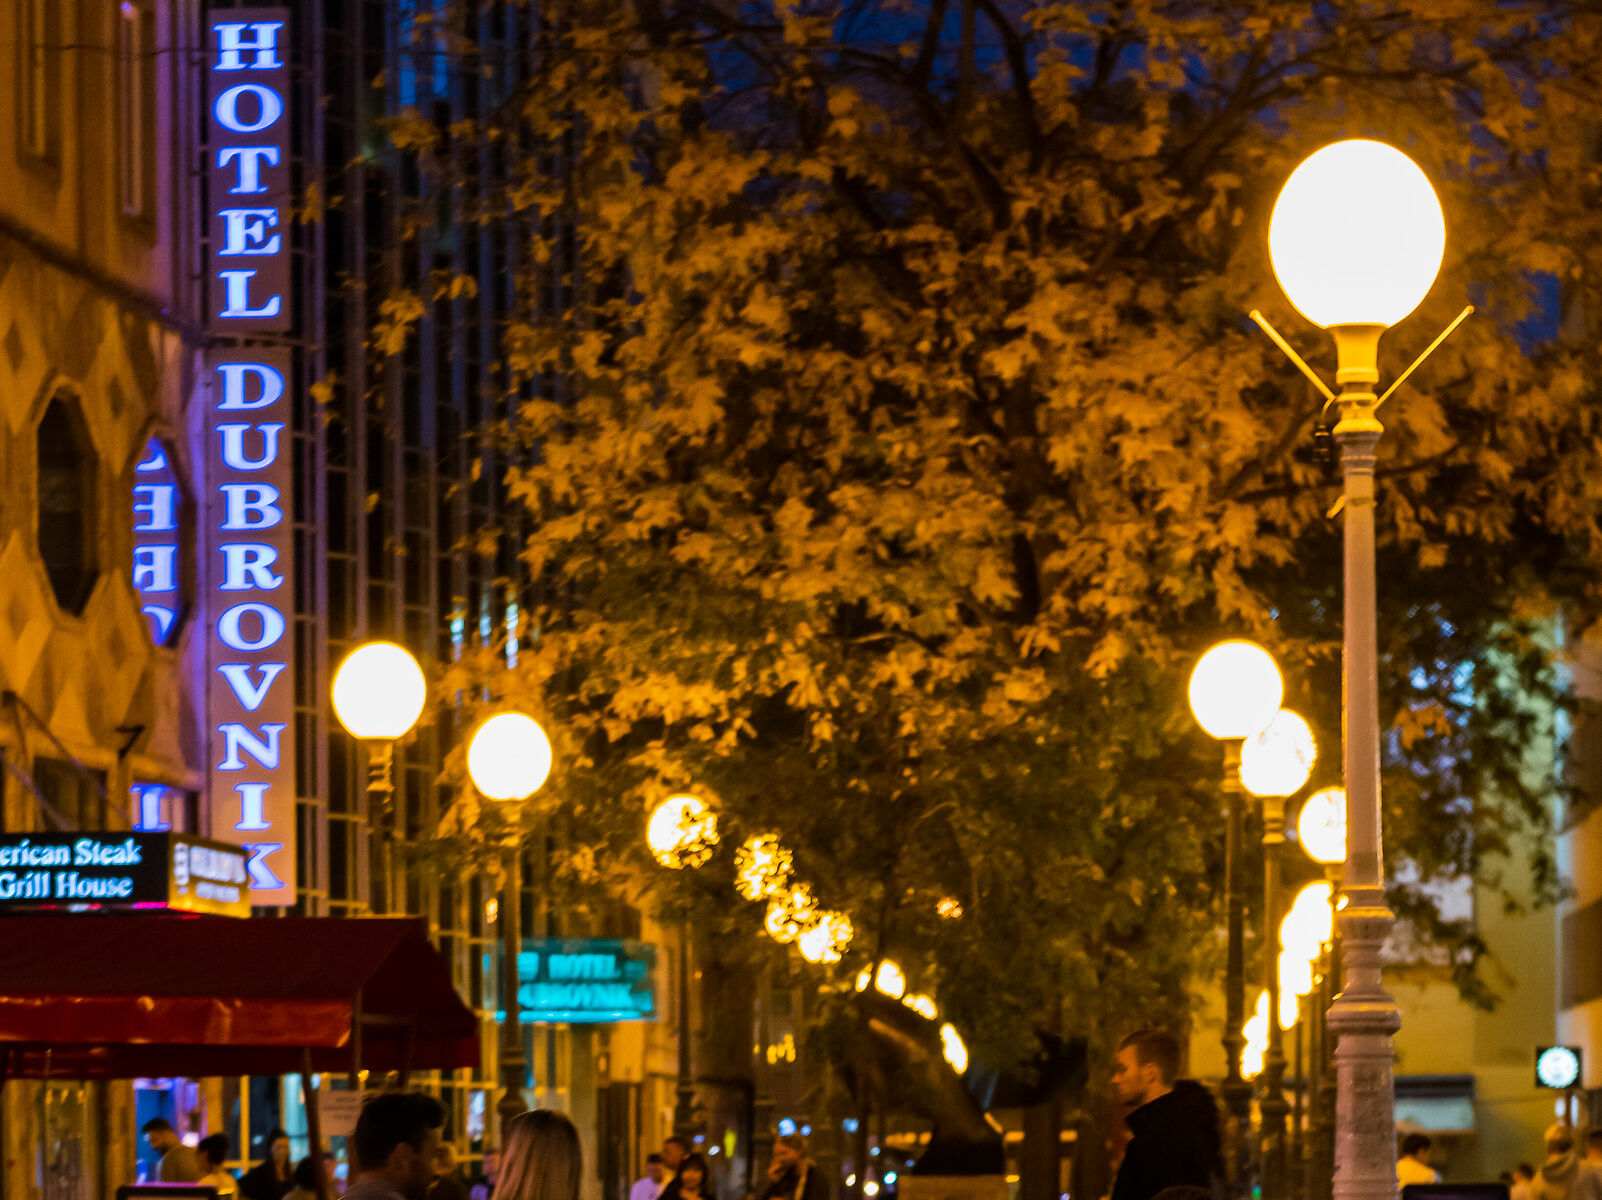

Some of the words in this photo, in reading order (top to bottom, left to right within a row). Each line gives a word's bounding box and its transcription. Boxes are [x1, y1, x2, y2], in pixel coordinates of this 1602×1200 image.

[212, 21, 285, 319] HOTEL
[213, 362, 287, 890] DUBROVNIK
[0, 871, 51, 899] Grill
[55, 871, 134, 898] House
[75, 838, 143, 866] Steak
